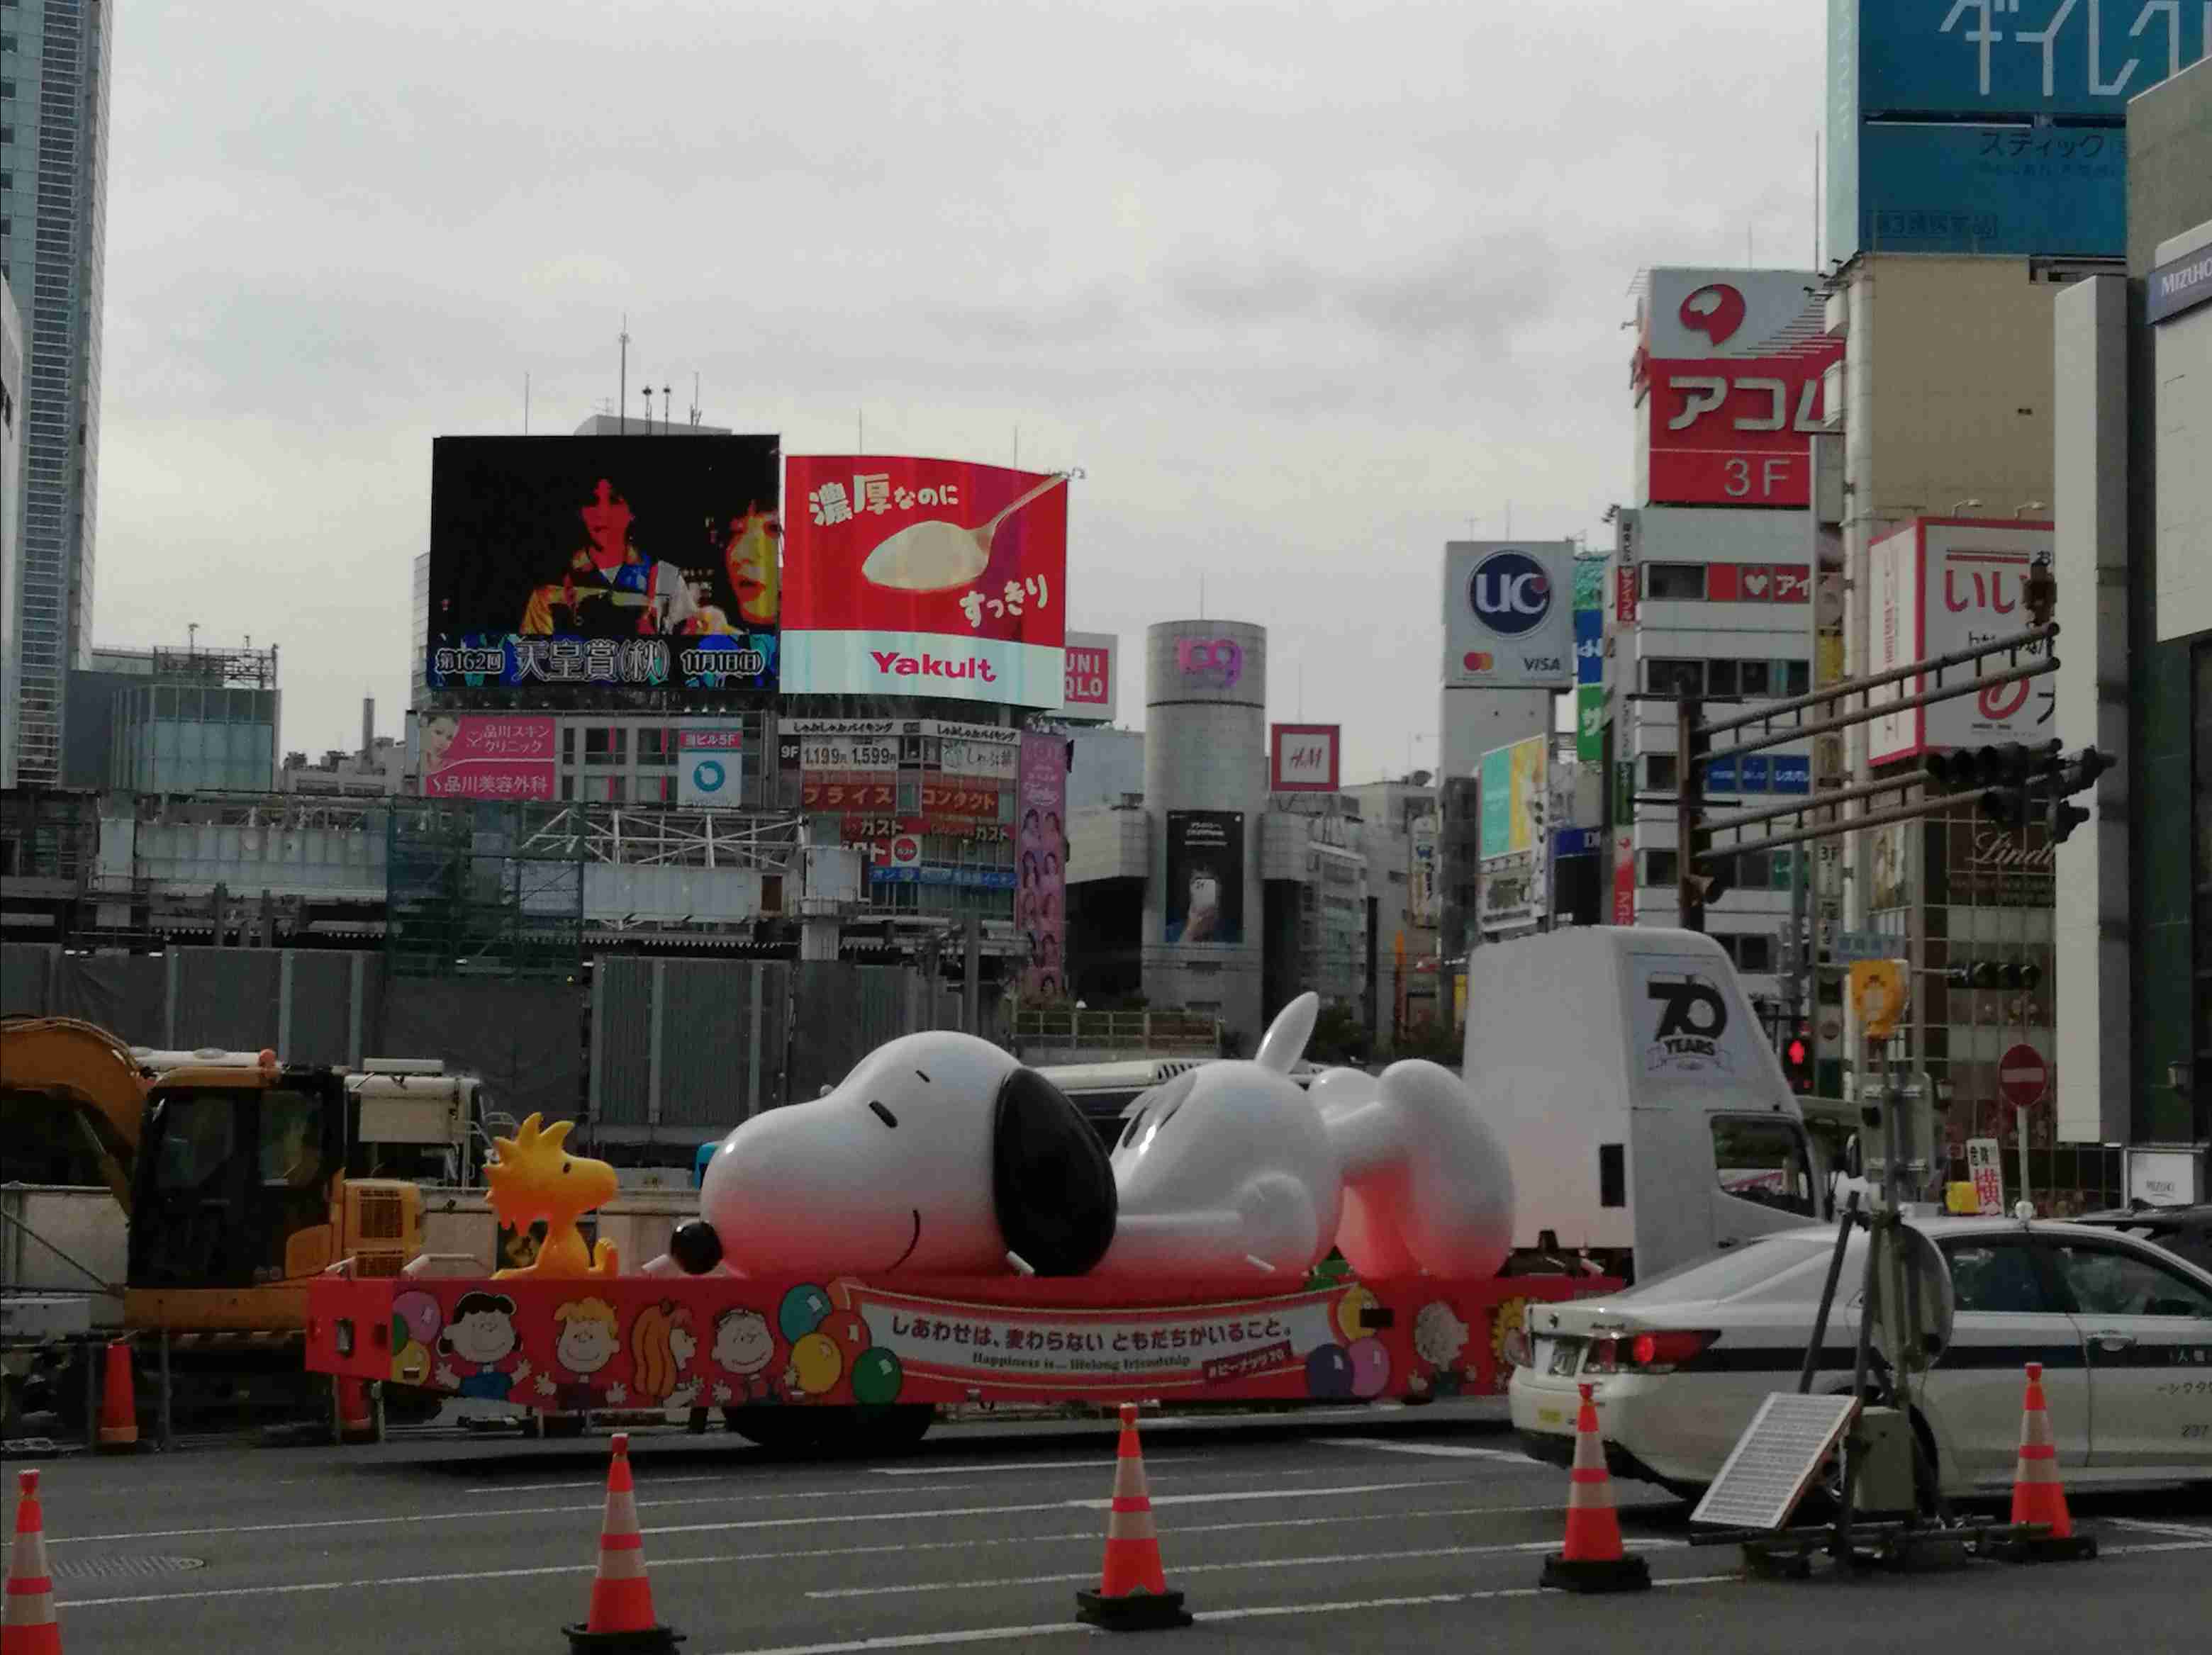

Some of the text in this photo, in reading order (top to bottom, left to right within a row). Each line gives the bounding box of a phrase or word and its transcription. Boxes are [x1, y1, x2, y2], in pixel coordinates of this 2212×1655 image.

[1939, 0, 2212, 97] ダイレク
[1724, 459, 1792, 497] 3F
[808, 473, 959, 527] 濃厚なのに
[959, 573, 1048, 629] すっきり
[871, 651, 998, 682] Yakult
[1524, 657, 1560, 671] VISA
[484, 724, 551, 739] 品川スキン
[485, 739, 543, 753] クリニック
[781, 745, 799, 758] 9F
[444, 776, 547, 792] 品川美容外科
